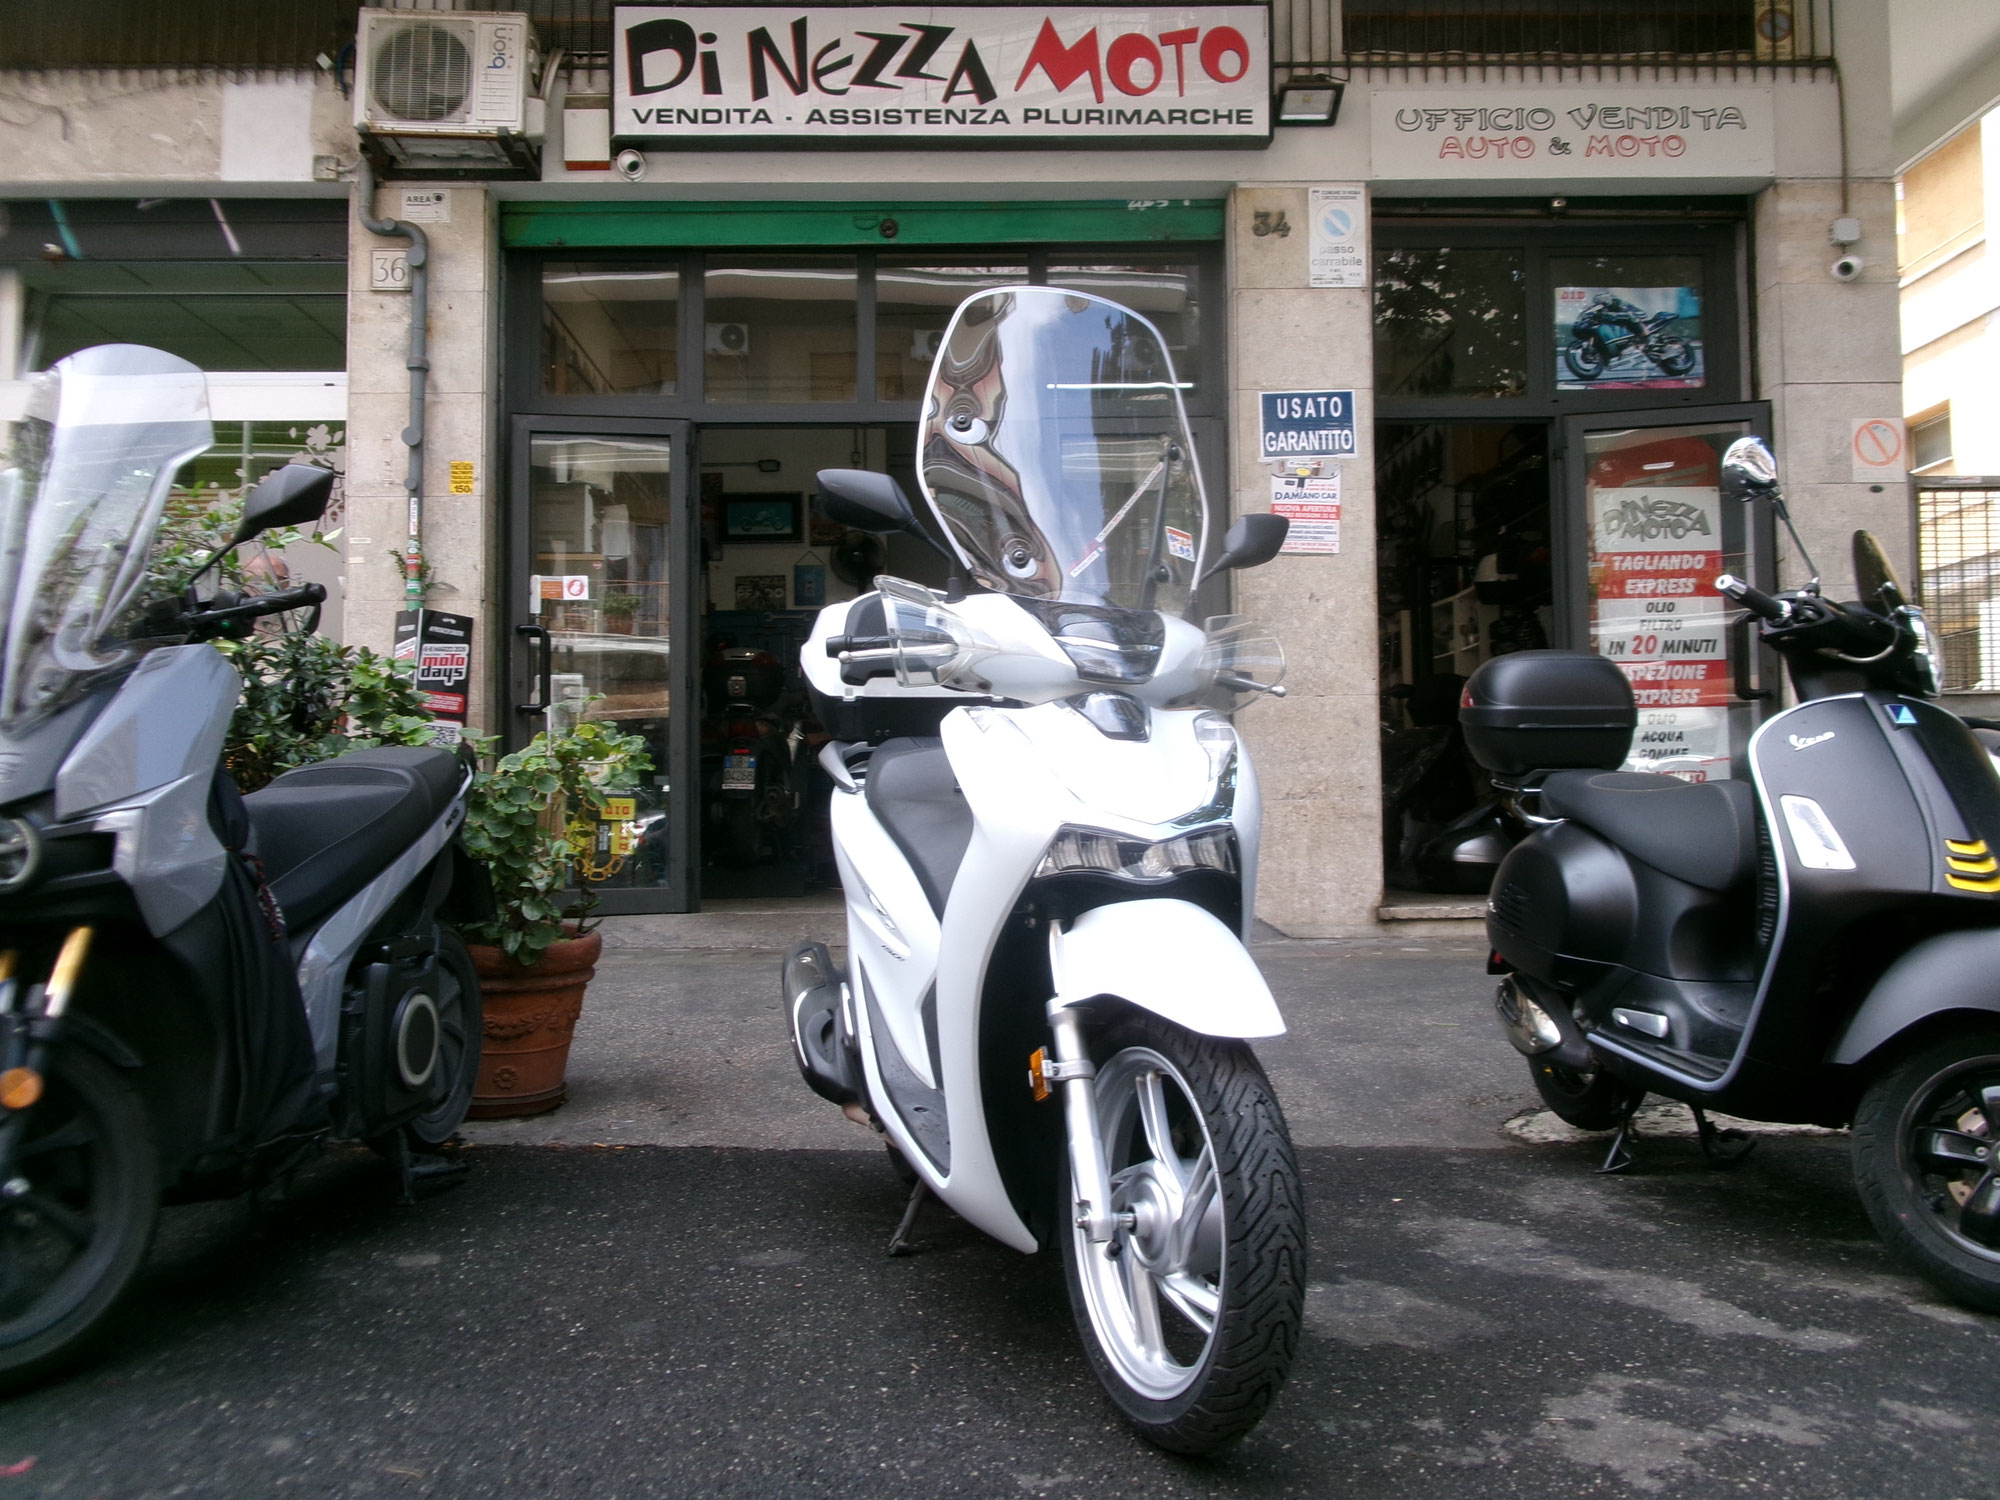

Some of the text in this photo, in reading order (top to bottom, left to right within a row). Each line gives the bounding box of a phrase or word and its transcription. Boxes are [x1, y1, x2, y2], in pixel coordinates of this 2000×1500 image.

[624, 15, 1251, 104] Di NEZZA MOTO
[631, 107, 774, 126] VENDITA
[804, 107, 1012, 126] ASSISTENZA
[1023, 107, 1255, 126] PLURIMARCHE
[1395, 103, 1748, 132] UFFICIO VENDITA
[1439, 134, 1688, 159] AUTO & MOTO
[406, 195, 432, 203] AREA
[374, 257, 406, 282] 36
[1276, 397, 1342, 419] USATO
[1265, 429, 1353, 452] GARANTITO
[1274, 491, 1338, 501] DAMIANO CAR
[1620, 517, 1688, 542] MOTO
[1612, 554, 1706, 571] TAGLIANDO
[1625, 578, 1696, 595] EXPRESS
[1646, 602, 1676, 613] OLIO
[1608, 634, 1718, 656] IN 20 MINUTI
[420, 666, 464, 683] days
[1633, 688, 1701, 705] EXPRESS
[1640, 731, 1684, 743] ACQUA
